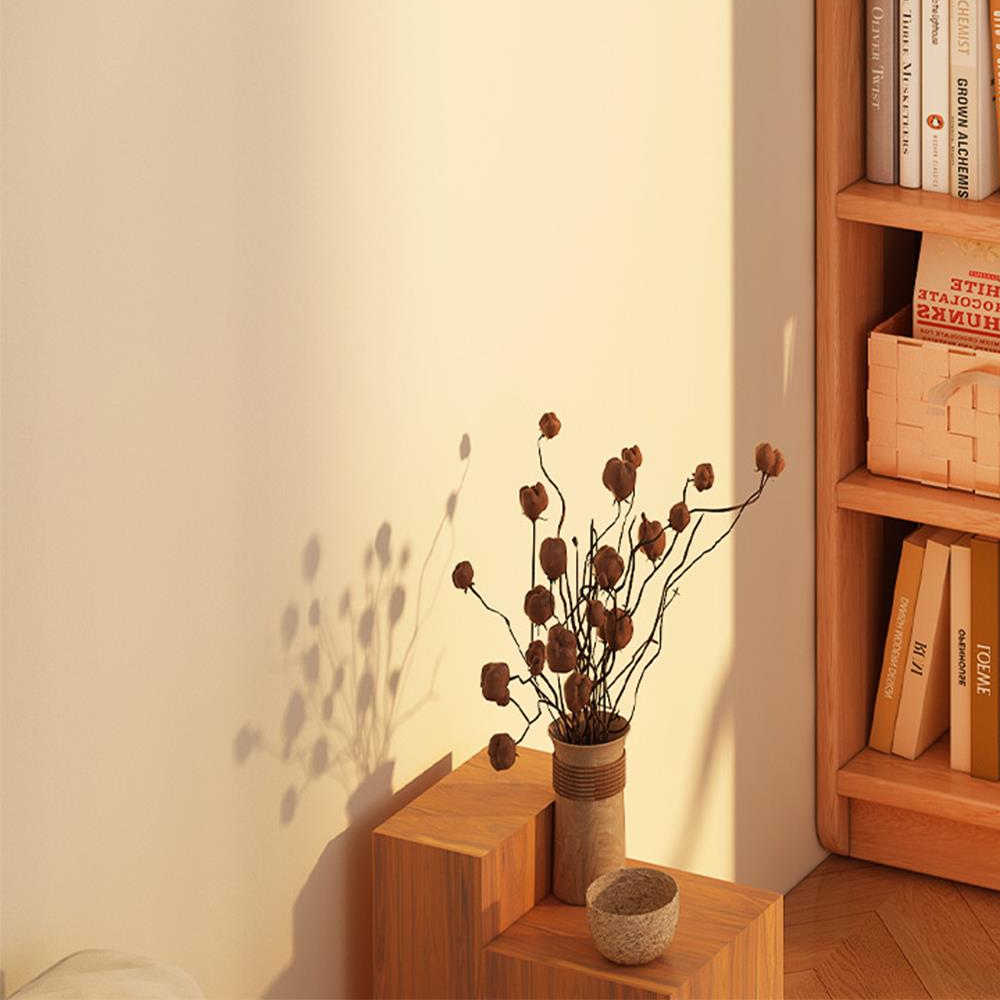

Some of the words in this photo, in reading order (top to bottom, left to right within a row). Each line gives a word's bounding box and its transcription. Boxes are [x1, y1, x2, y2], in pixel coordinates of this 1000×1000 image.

[872, 6, 884, 60] OLIVER
[902, 63, 912, 155] MUSKETEERS
[957, 78, 968, 128] GROWN
